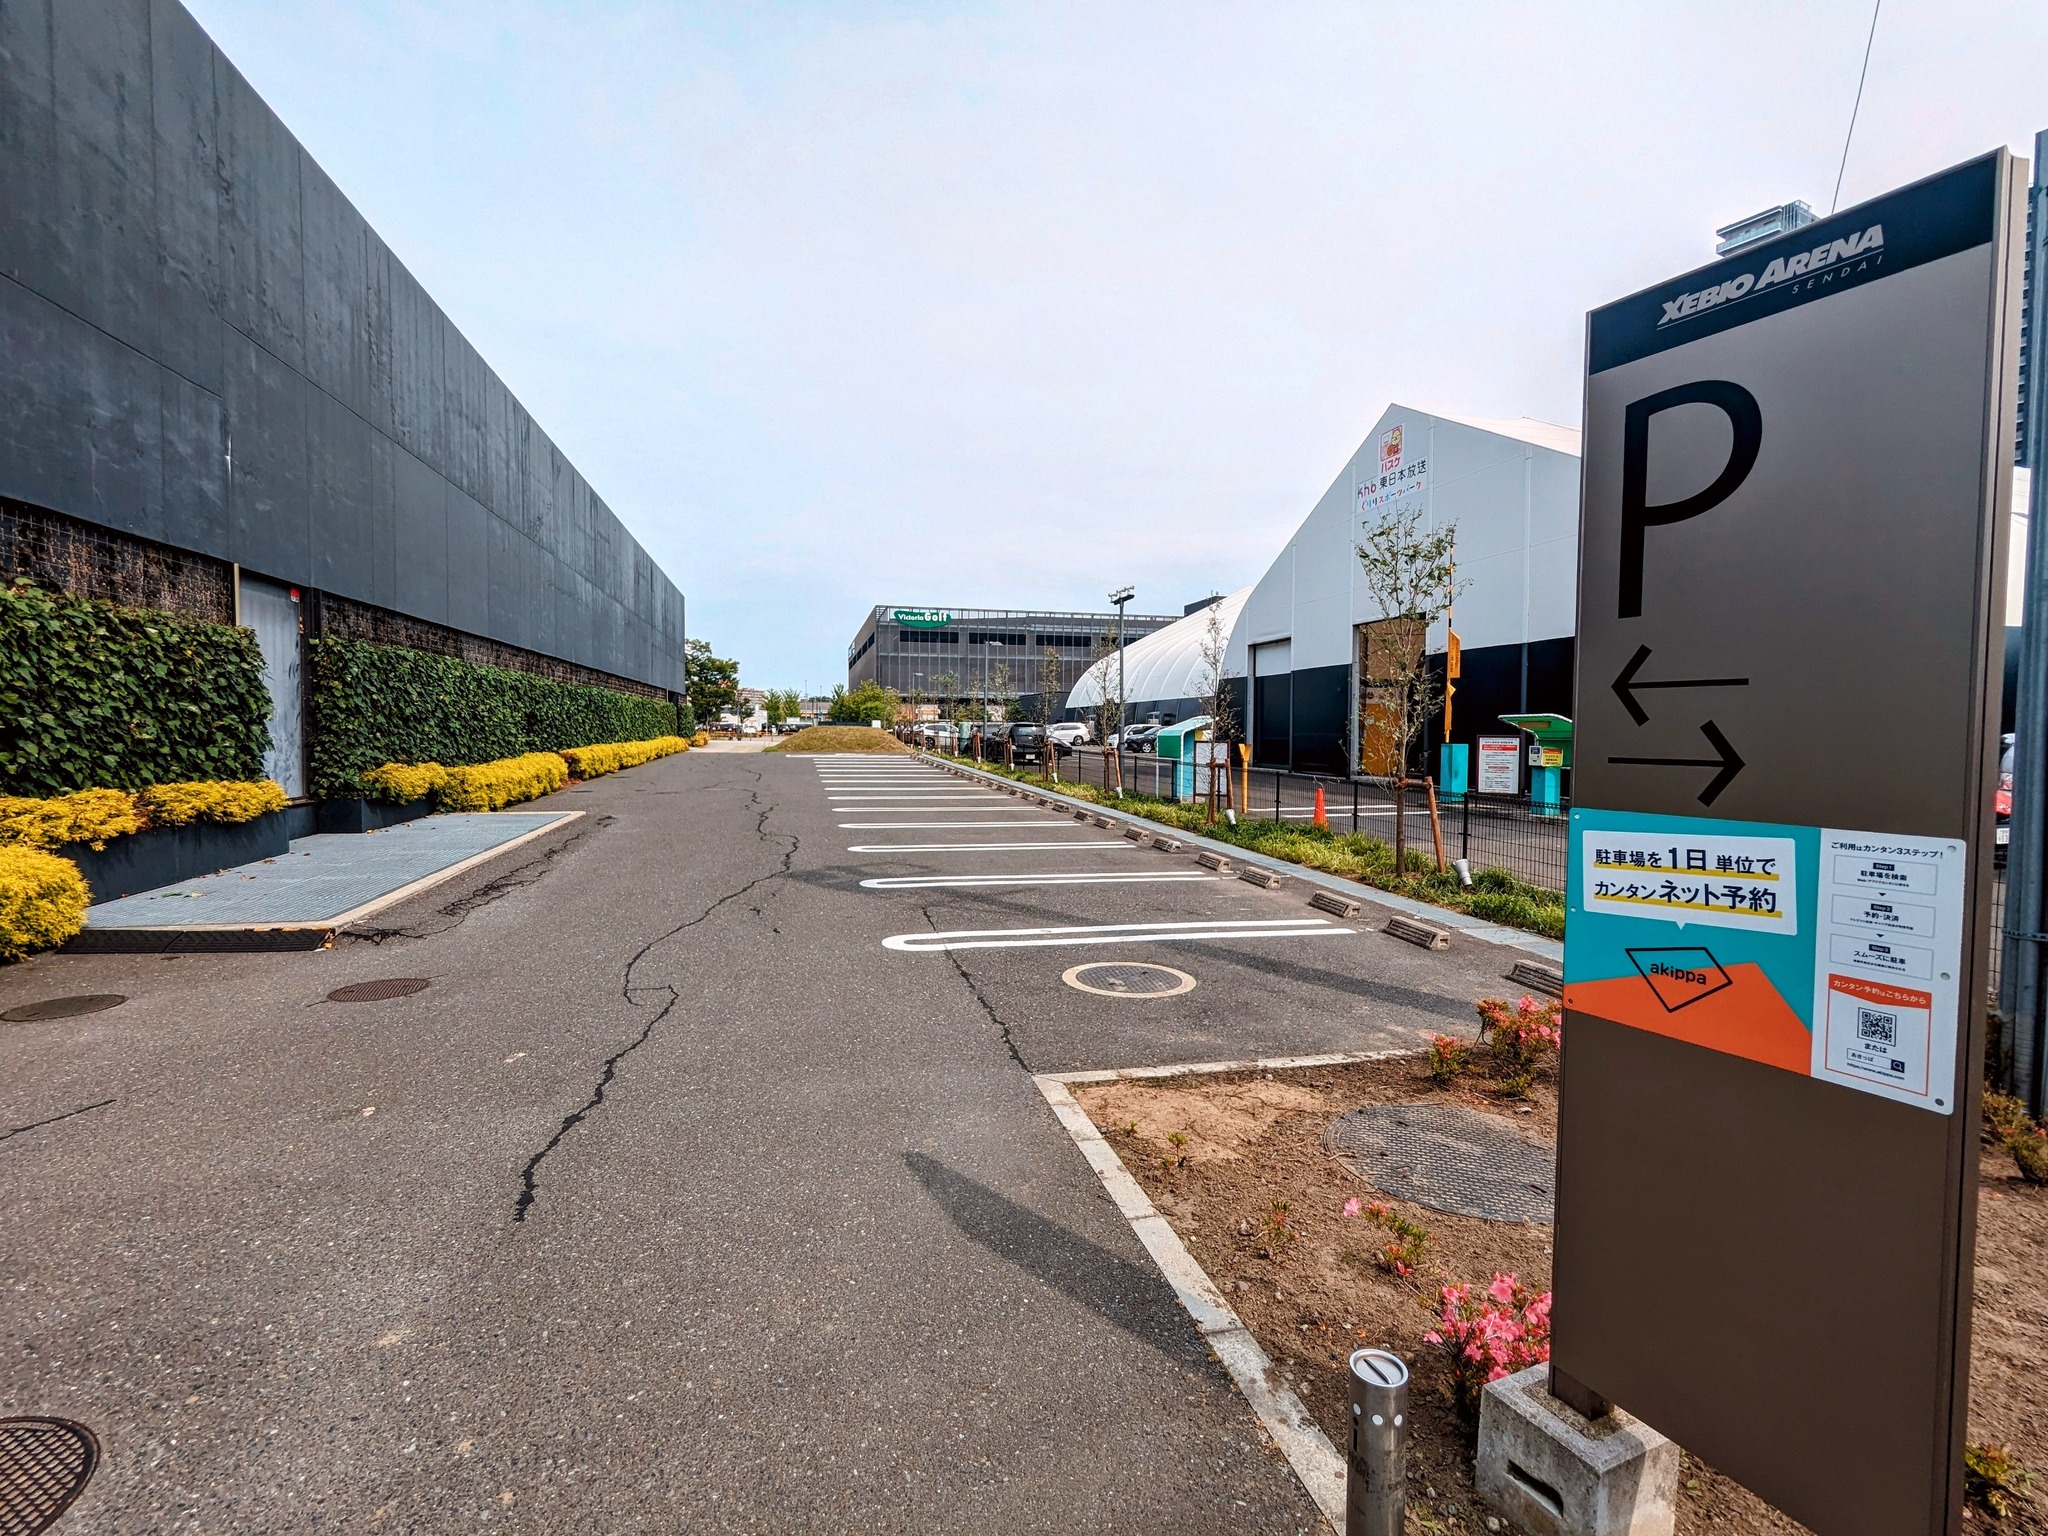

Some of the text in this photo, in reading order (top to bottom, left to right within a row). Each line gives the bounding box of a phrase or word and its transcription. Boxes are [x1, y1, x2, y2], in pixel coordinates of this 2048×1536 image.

[1657, 224, 1884, 325] XEBIO ARENA
[1791, 255, 1883, 294] SENDAI
[1379, 458, 1427, 491] 東日本放送
[1618, 379, 1763, 619] P
[897, 611, 948, 622] Victoria Golf
[1875, 863, 1889, 871] Step
[1594, 879, 1777, 913] カンタンネット予約
[1853, 950, 1907, 965] スムーズに駐車
[1650, 962, 1707, 985] akippa
[1833, 980, 1926, 1005] カンタン予約はこちらから
[1864, 1042, 1888, 1054] または
